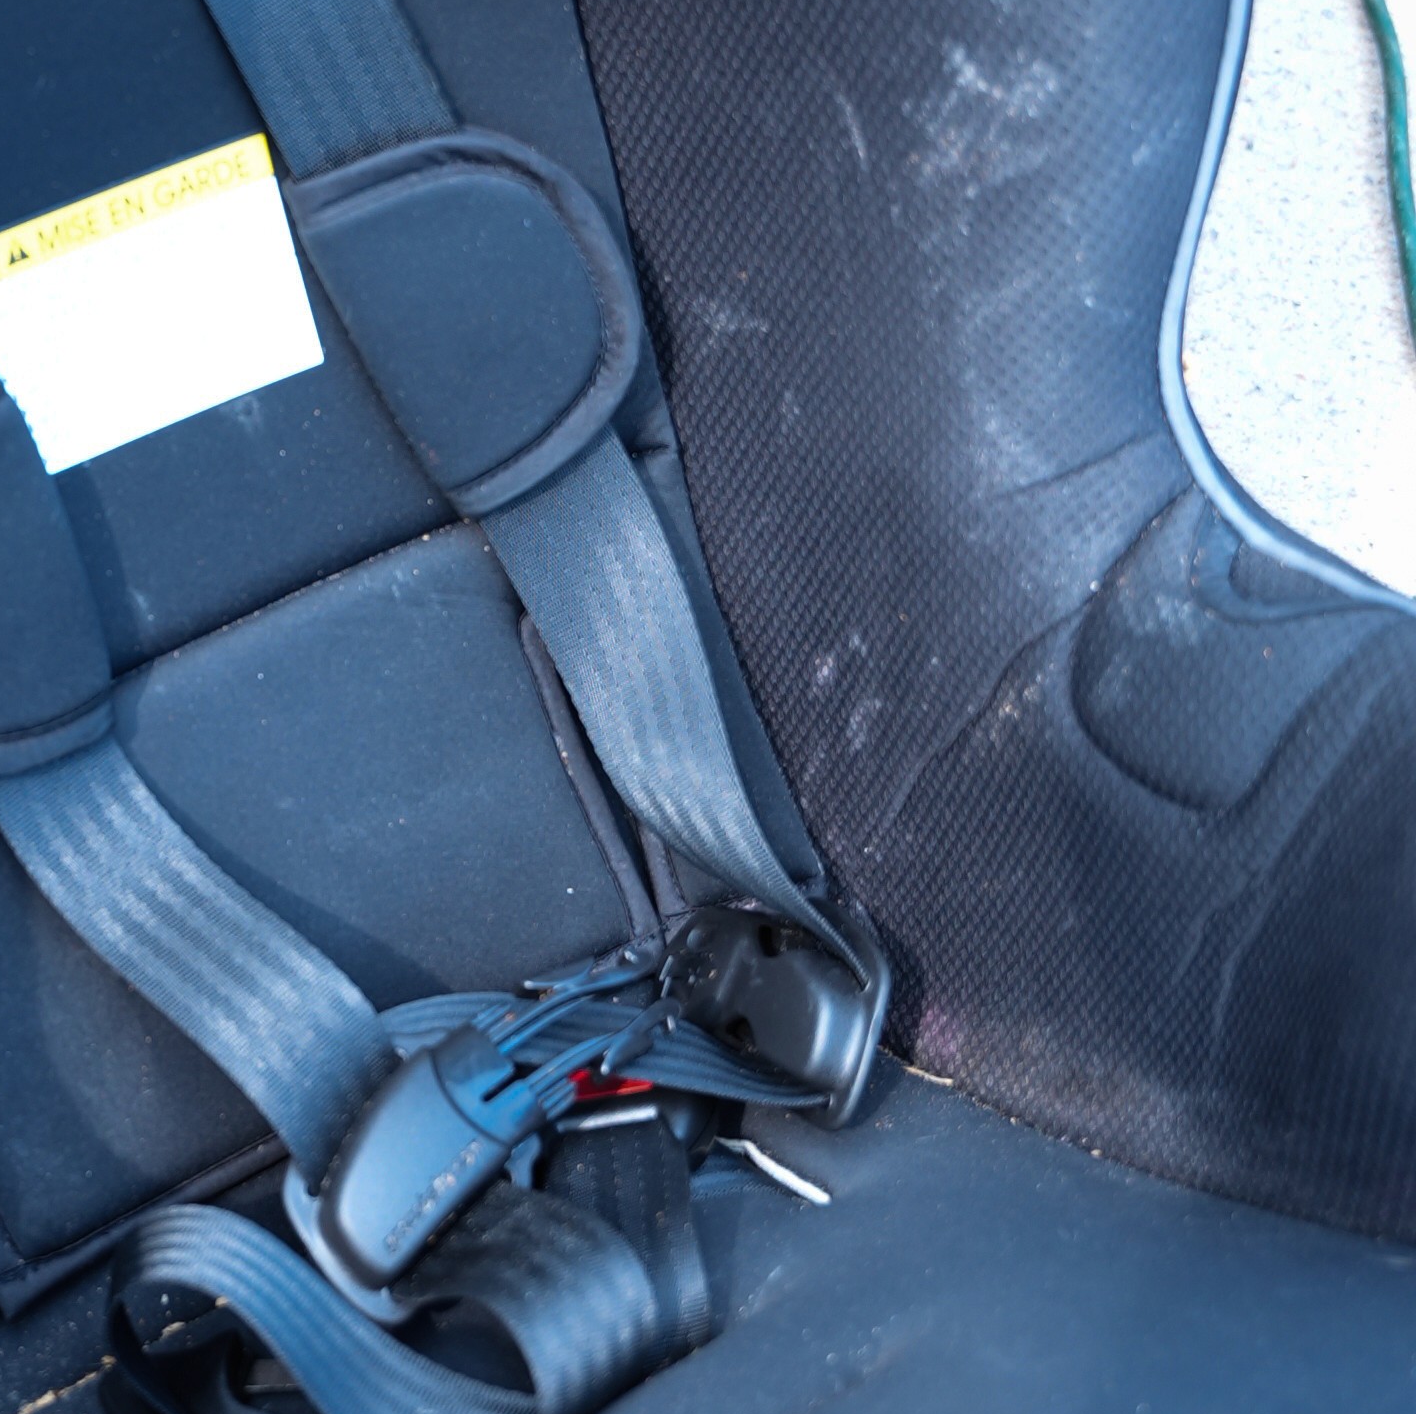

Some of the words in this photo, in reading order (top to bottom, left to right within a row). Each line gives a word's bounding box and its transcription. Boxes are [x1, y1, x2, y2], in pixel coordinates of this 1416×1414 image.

[36, 208, 102, 255] MISE
[107, 189, 146, 227] EN
[152, 149, 251, 209] GARDE
